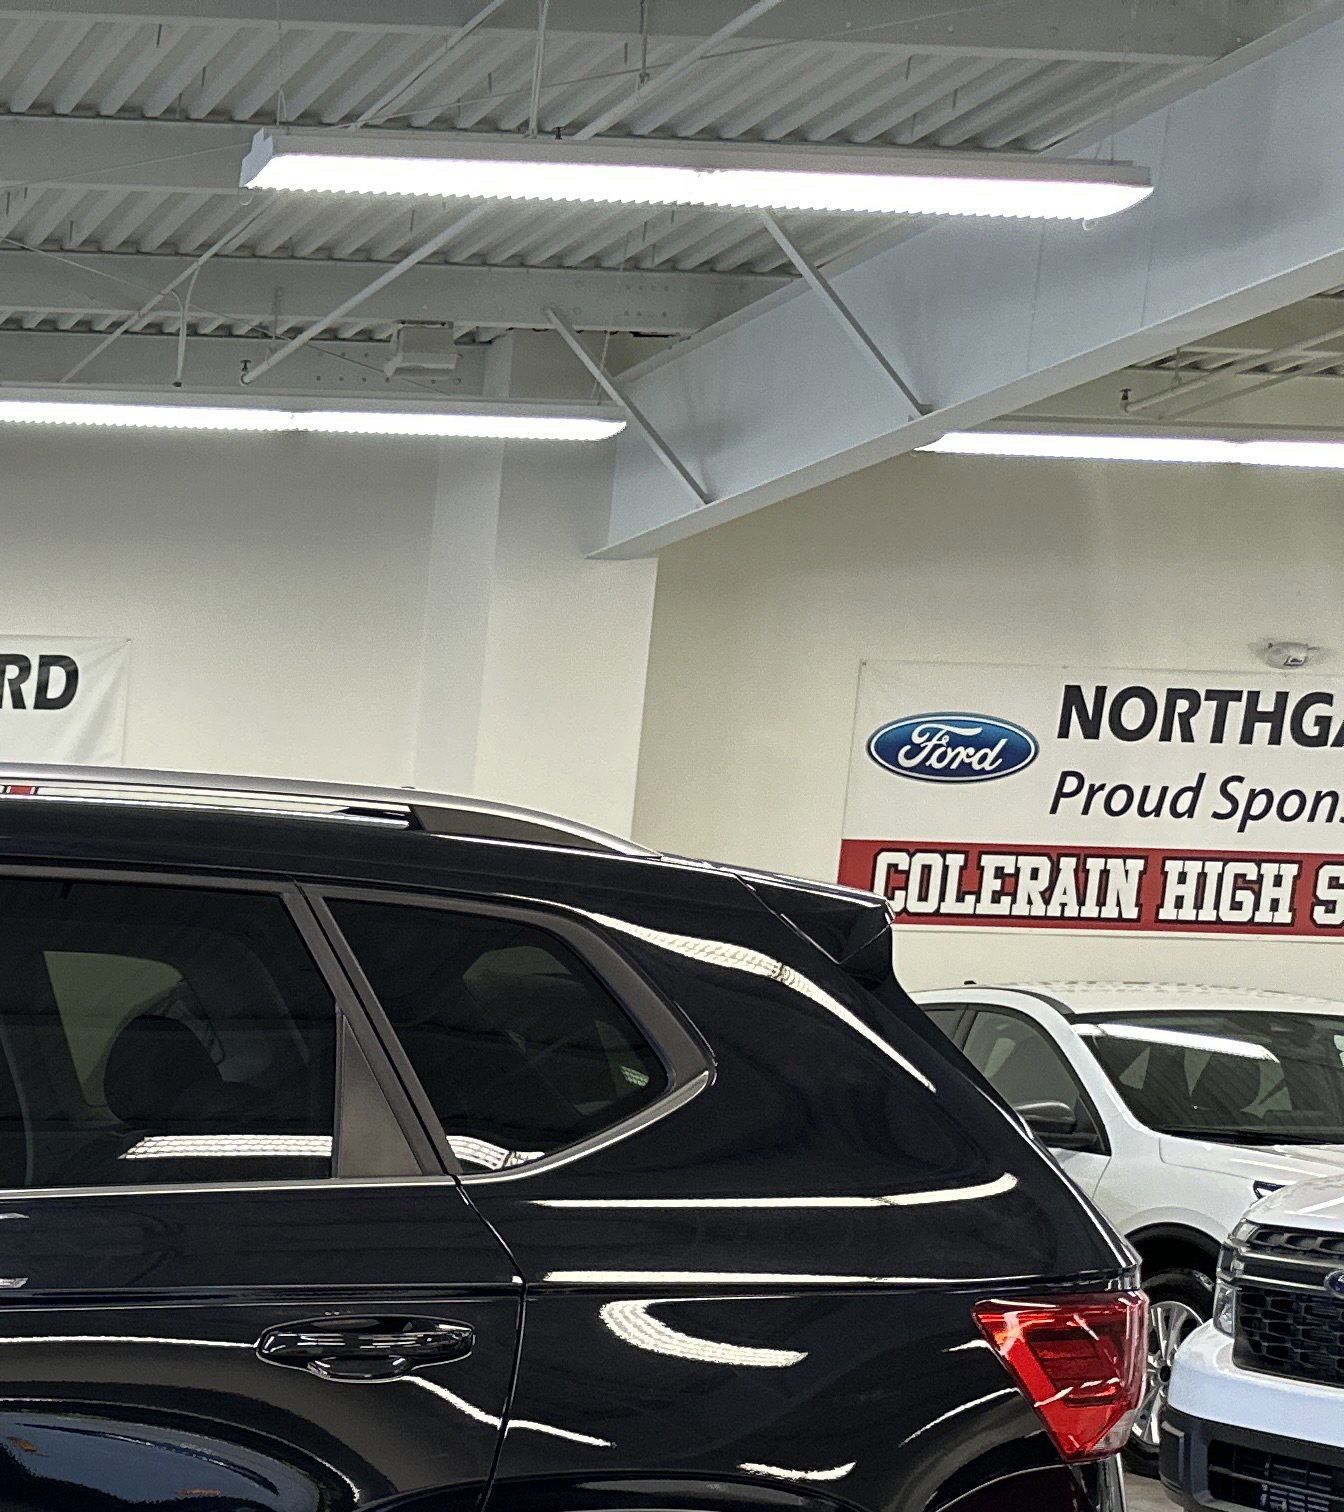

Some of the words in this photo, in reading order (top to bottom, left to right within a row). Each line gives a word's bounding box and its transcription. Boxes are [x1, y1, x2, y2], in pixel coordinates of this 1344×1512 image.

[897, 722, 1008, 771] Ford
[1049, 770, 1207, 819] Proud
[1211, 775, 1344, 833] Spon
[873, 850, 1143, 920] COLERAIN
[1158, 860, 1300, 925] HIGH
